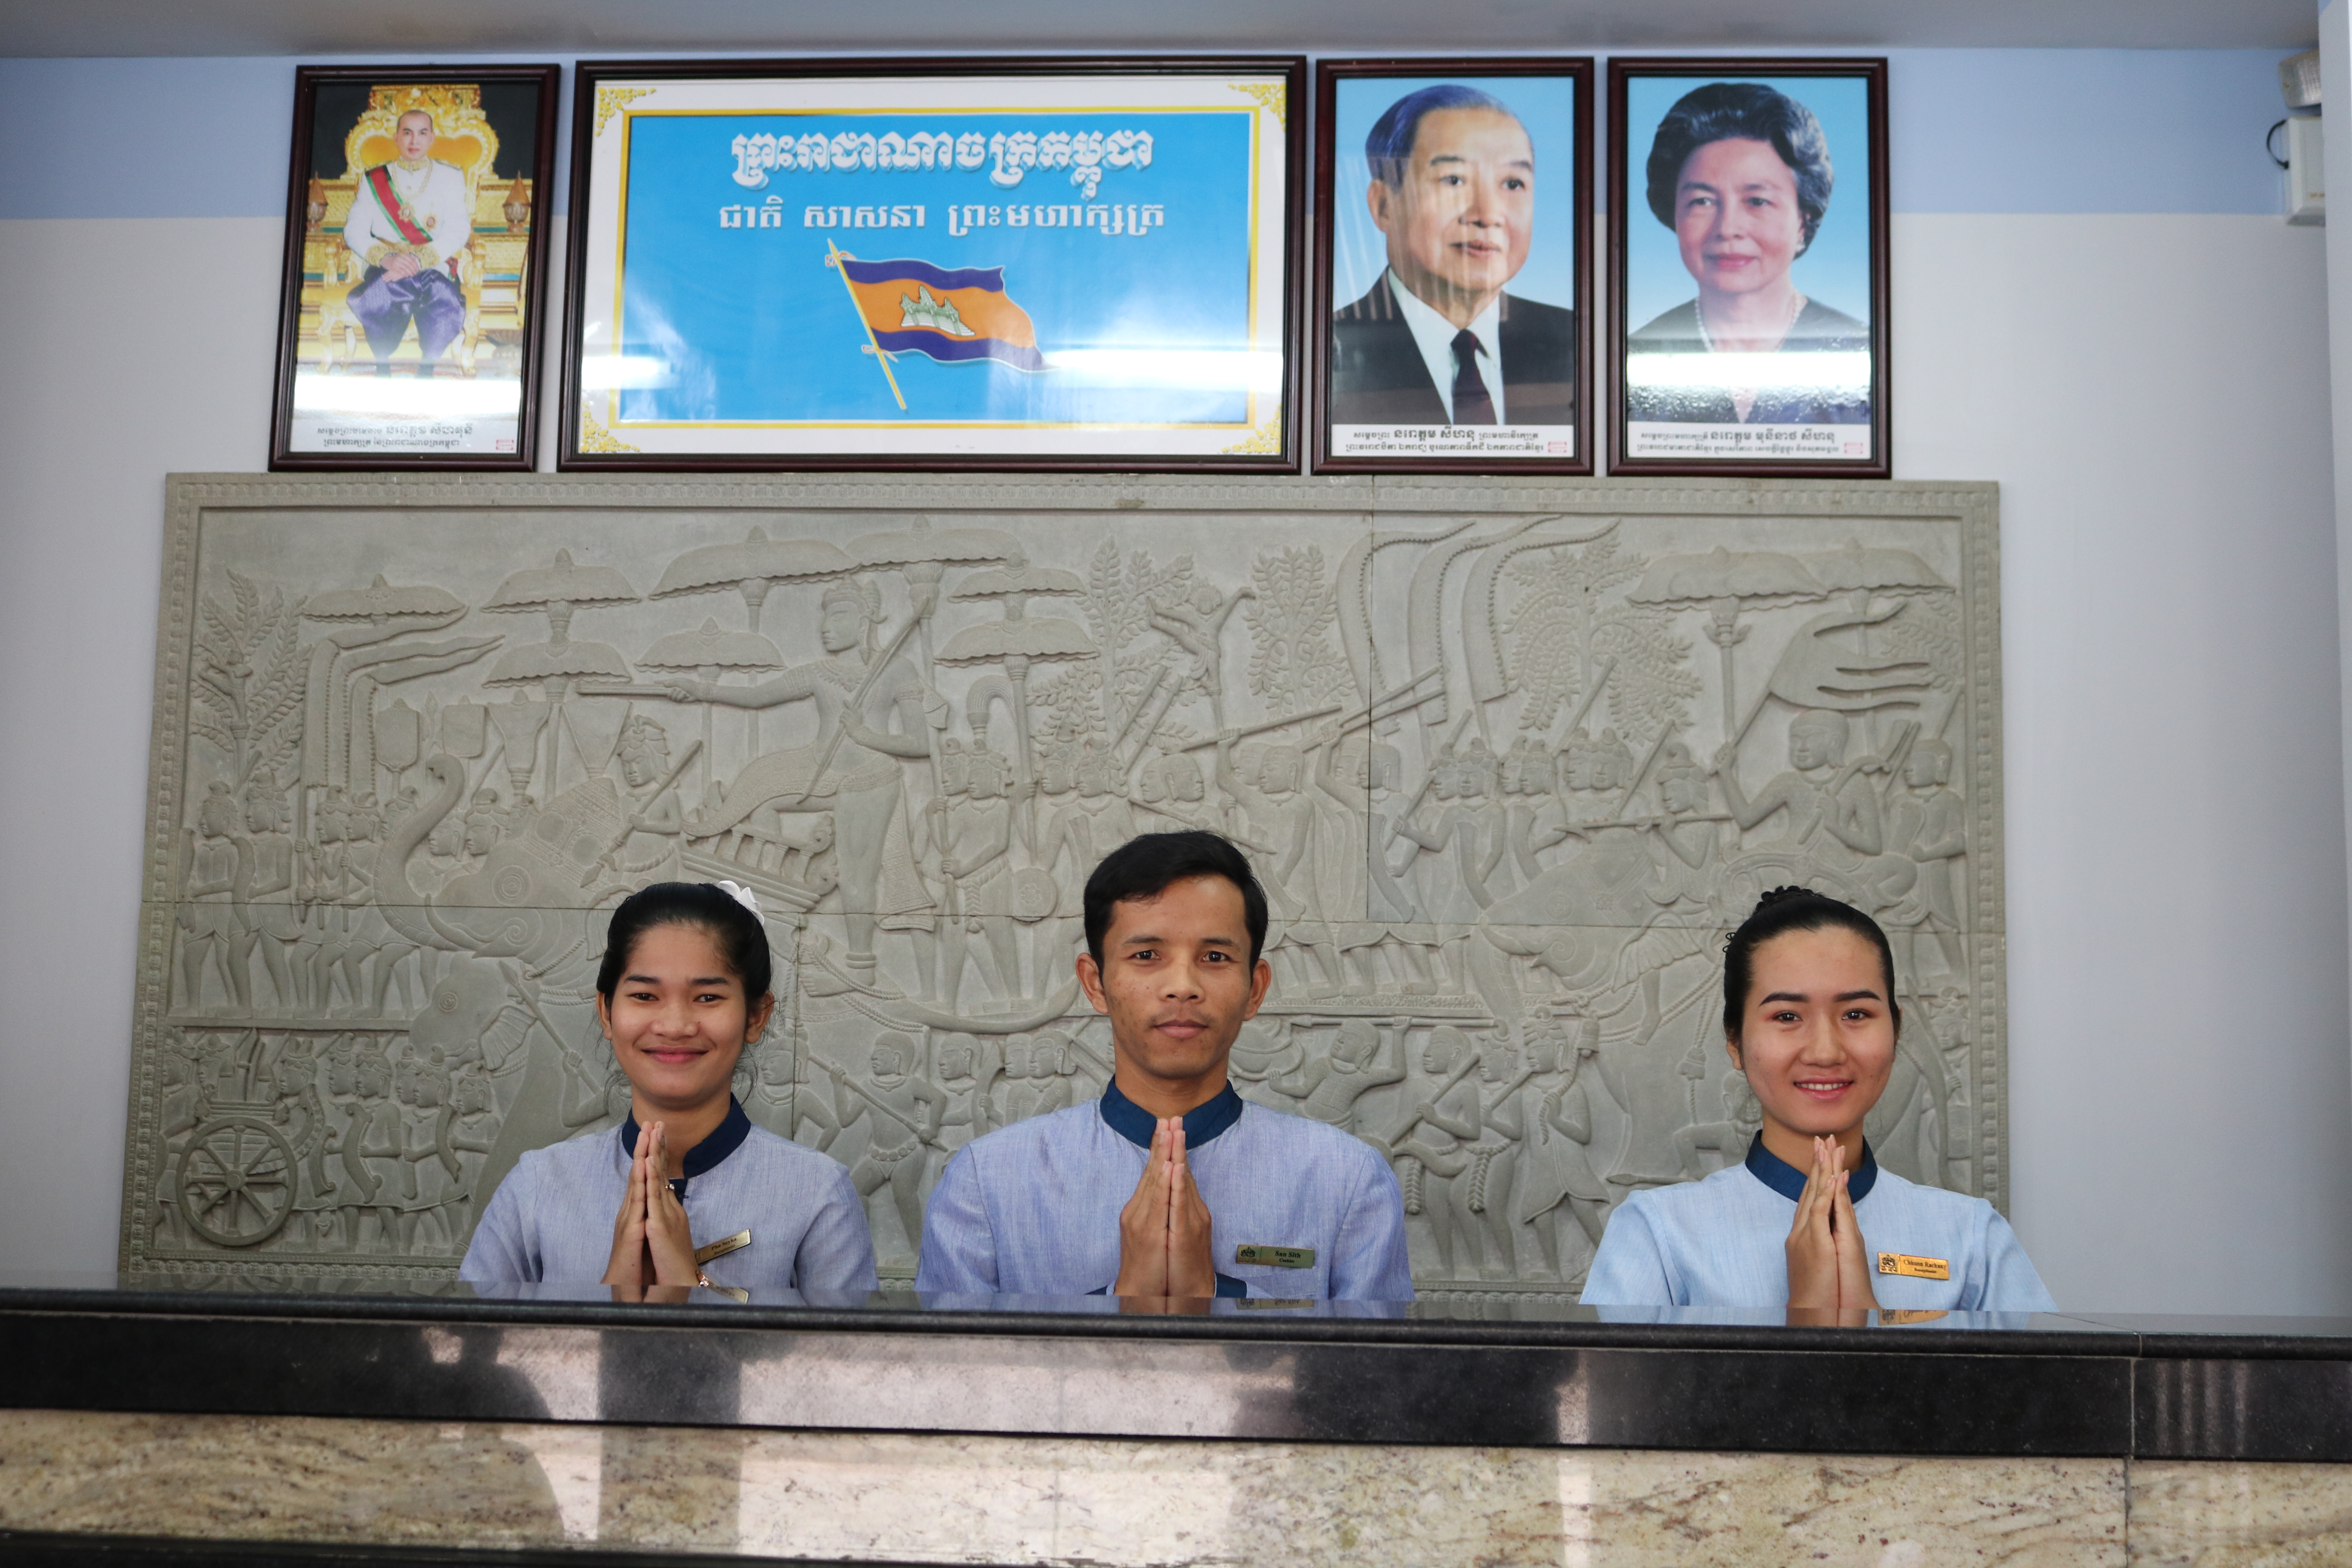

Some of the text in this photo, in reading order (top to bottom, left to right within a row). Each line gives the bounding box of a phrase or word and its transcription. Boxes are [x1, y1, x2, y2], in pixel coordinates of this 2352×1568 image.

[731, 131, 1154, 201] ព្រះរាជាណាចក្រកម្ពុជា
[719, 195, 1164, 236] ជាតិ សាសនា ព្រះមហាក្សត្រ
